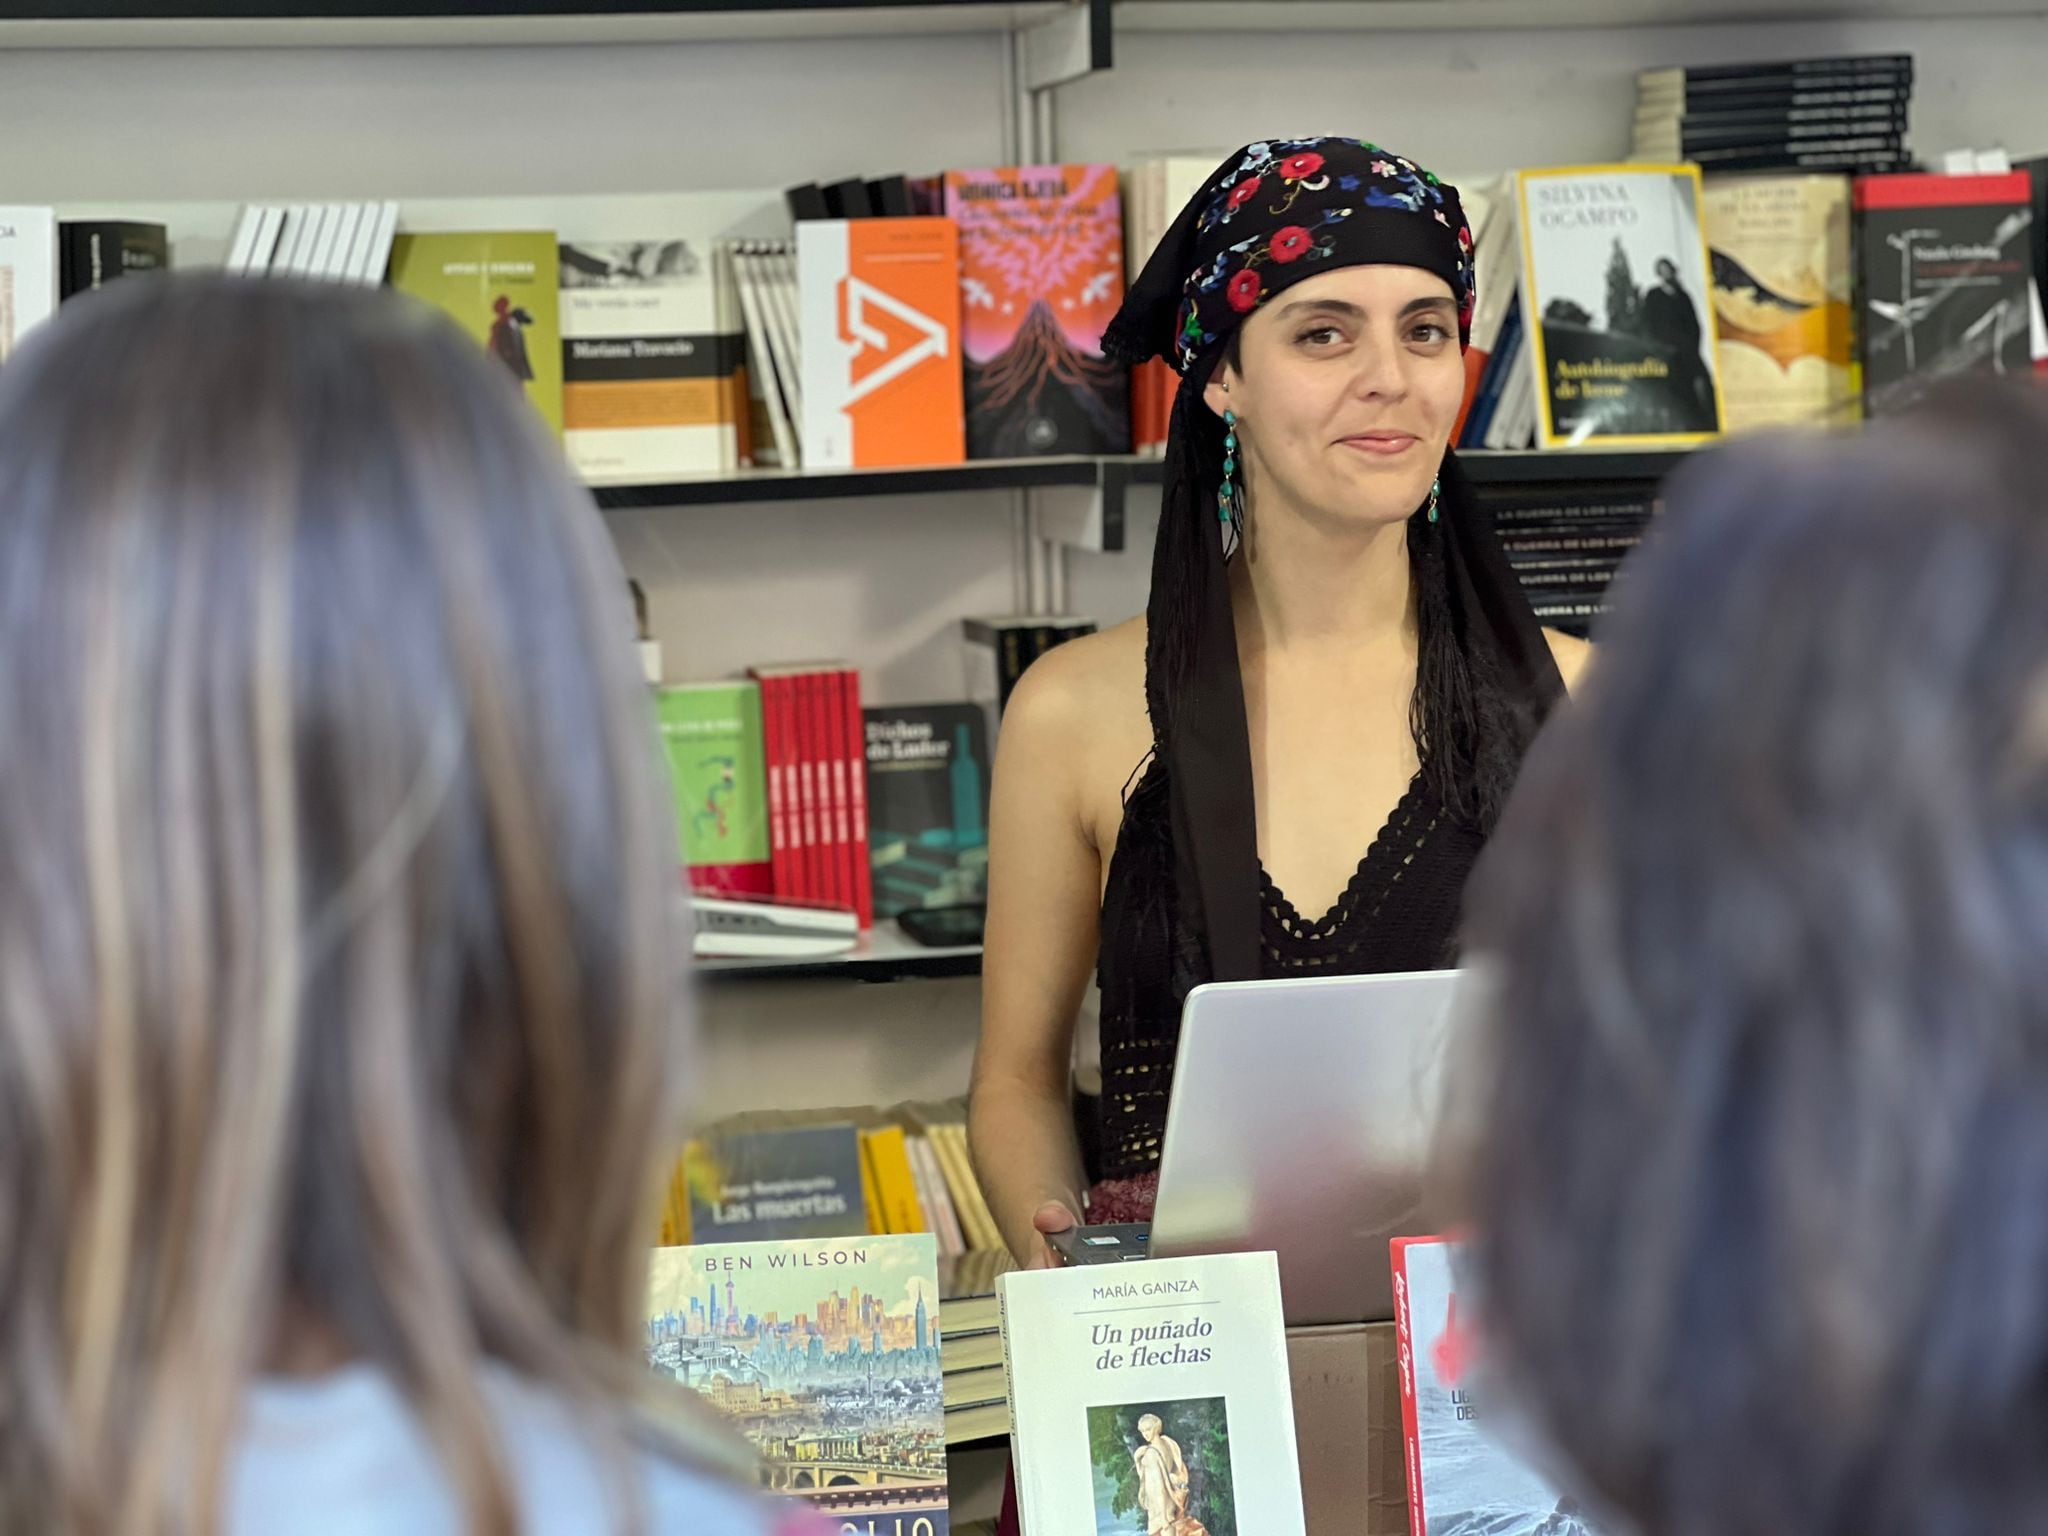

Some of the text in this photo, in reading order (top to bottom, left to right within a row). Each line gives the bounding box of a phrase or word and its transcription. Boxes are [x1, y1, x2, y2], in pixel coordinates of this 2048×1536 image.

[1539, 206, 1637, 228] OCAMPO
[1534, 605, 1574, 616] UERRA
[711, 1193, 848, 1225] Las muertas
[705, 1249, 867, 1272] BEN WILSON
[1092, 1279, 1200, 1300] MARÍA GAINZA
[1091, 1316, 1213, 1346] Un puñado
[1096, 1342, 1212, 1370] de flechas
